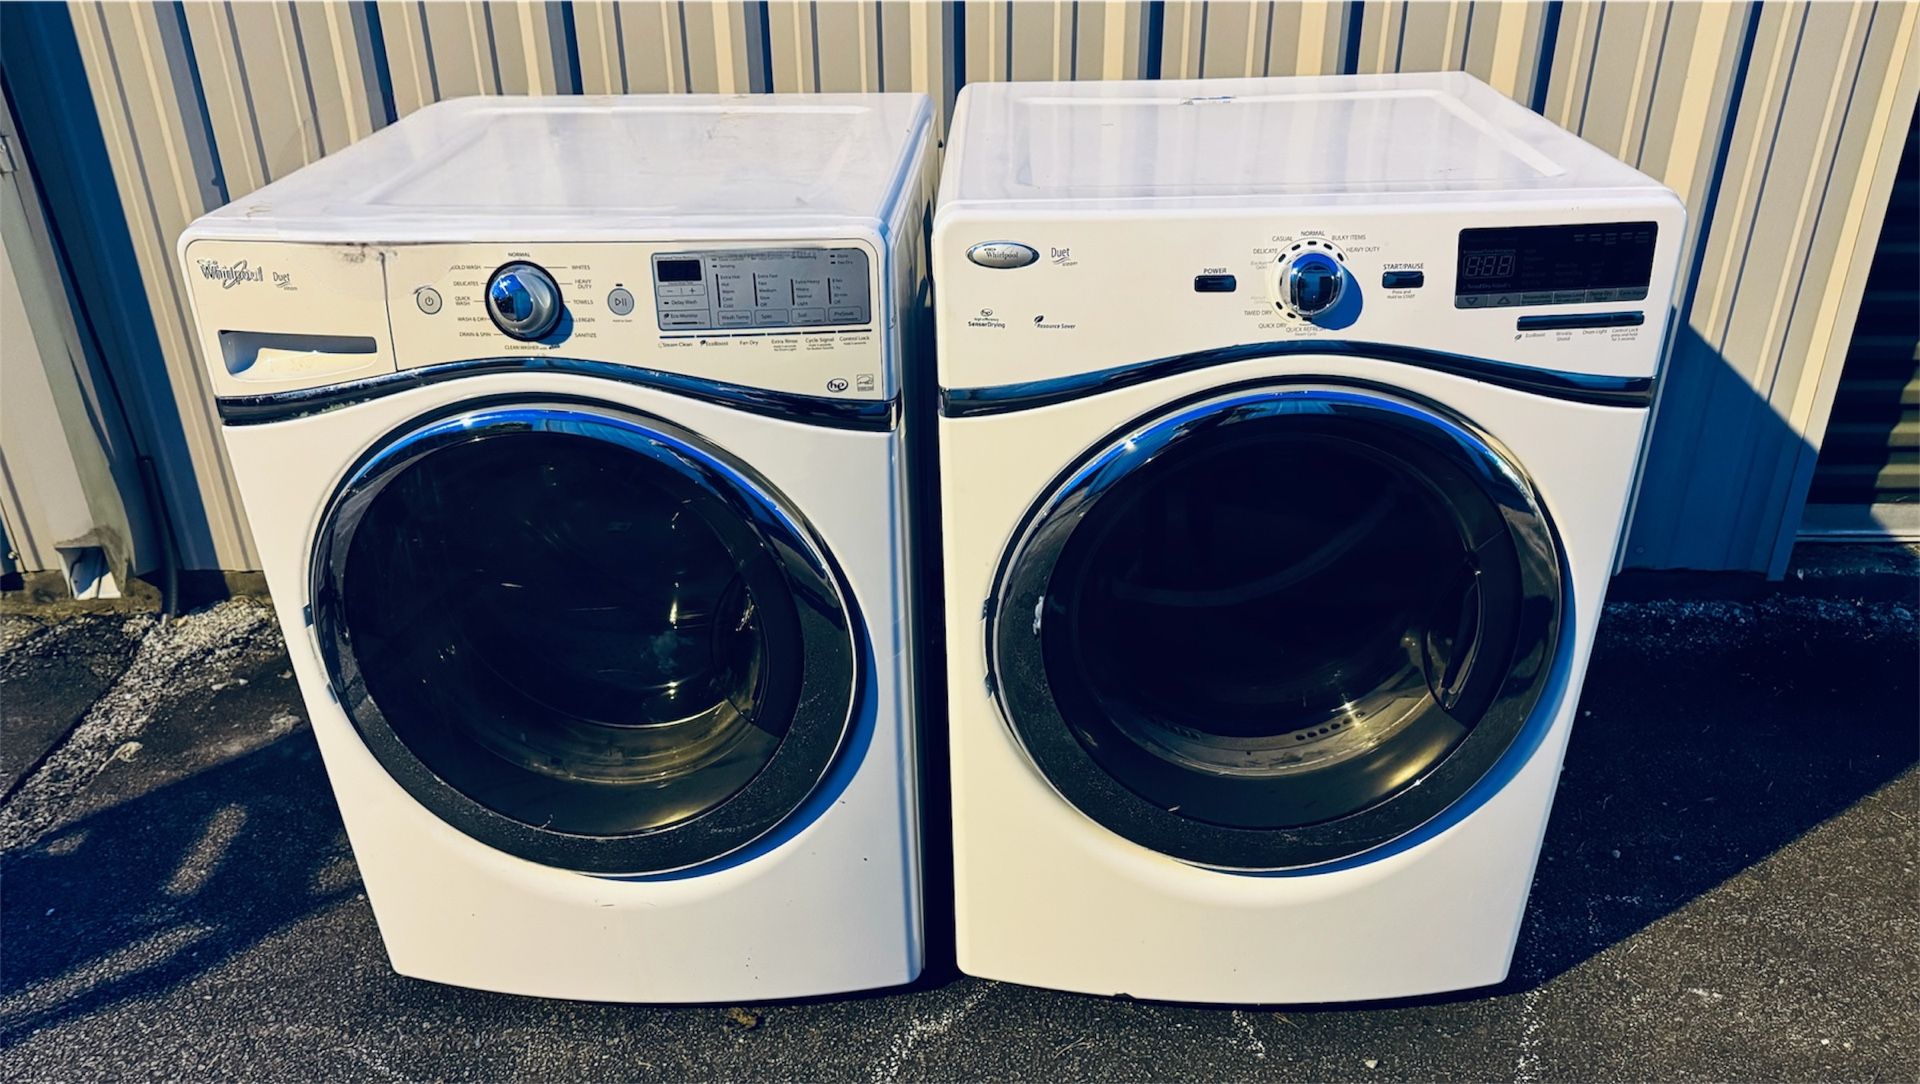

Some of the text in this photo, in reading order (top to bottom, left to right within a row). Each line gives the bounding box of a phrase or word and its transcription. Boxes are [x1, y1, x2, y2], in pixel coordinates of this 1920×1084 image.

[986, 249, 1019, 261] Whirlpool
[1051, 247, 1070, 258] Duet
[1383, 262, 1424, 270] START/PAUSE
[197, 260, 264, 290] Whirlpool
[272, 272, 290, 282] Duet
[968, 321, 1006, 329] SensorDrying
